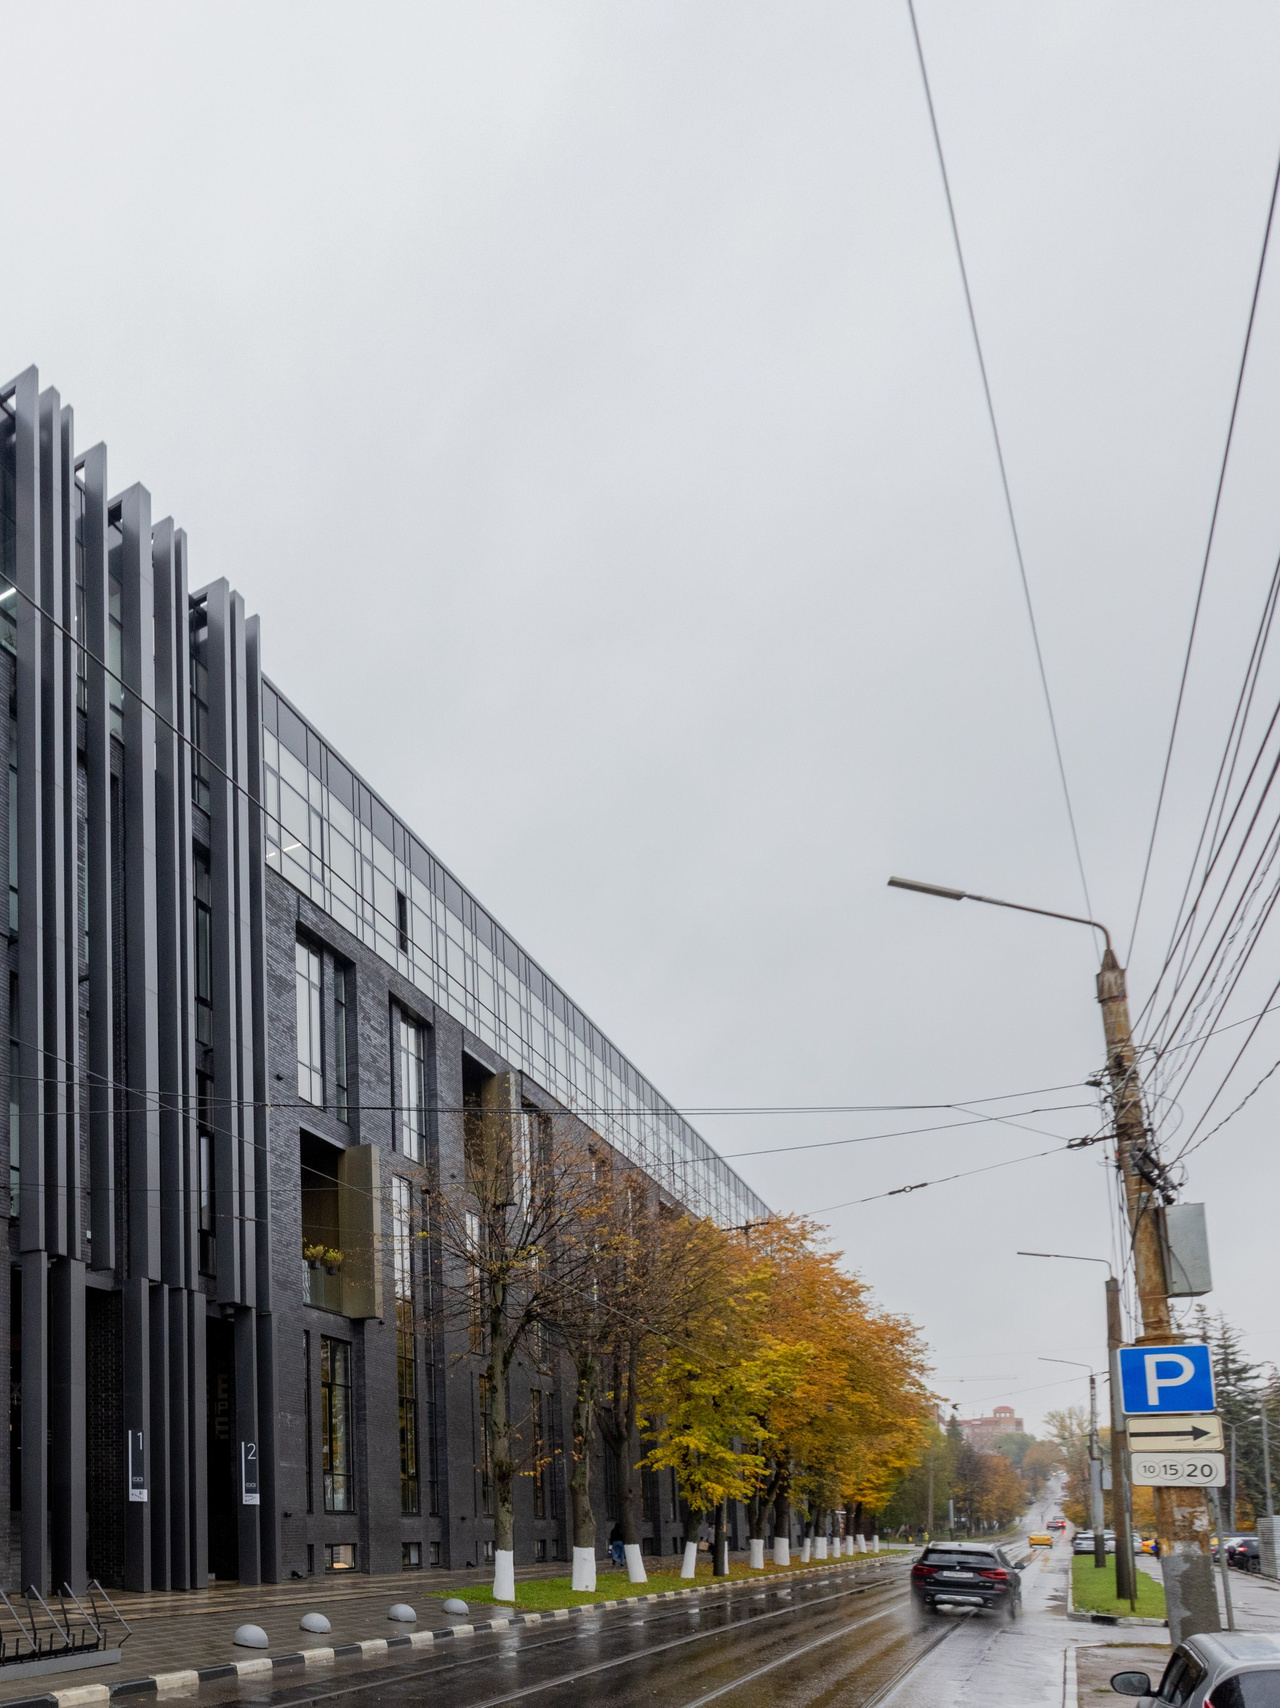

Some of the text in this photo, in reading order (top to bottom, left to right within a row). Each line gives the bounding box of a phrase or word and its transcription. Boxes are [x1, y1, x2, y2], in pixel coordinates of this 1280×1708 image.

[1144, 1353, 1195, 1406] P
[137, 1432, 143, 1450] 1
[247, 1443, 257, 1460] 2
[1142, 1463, 1213, 1478] 10 15 20
